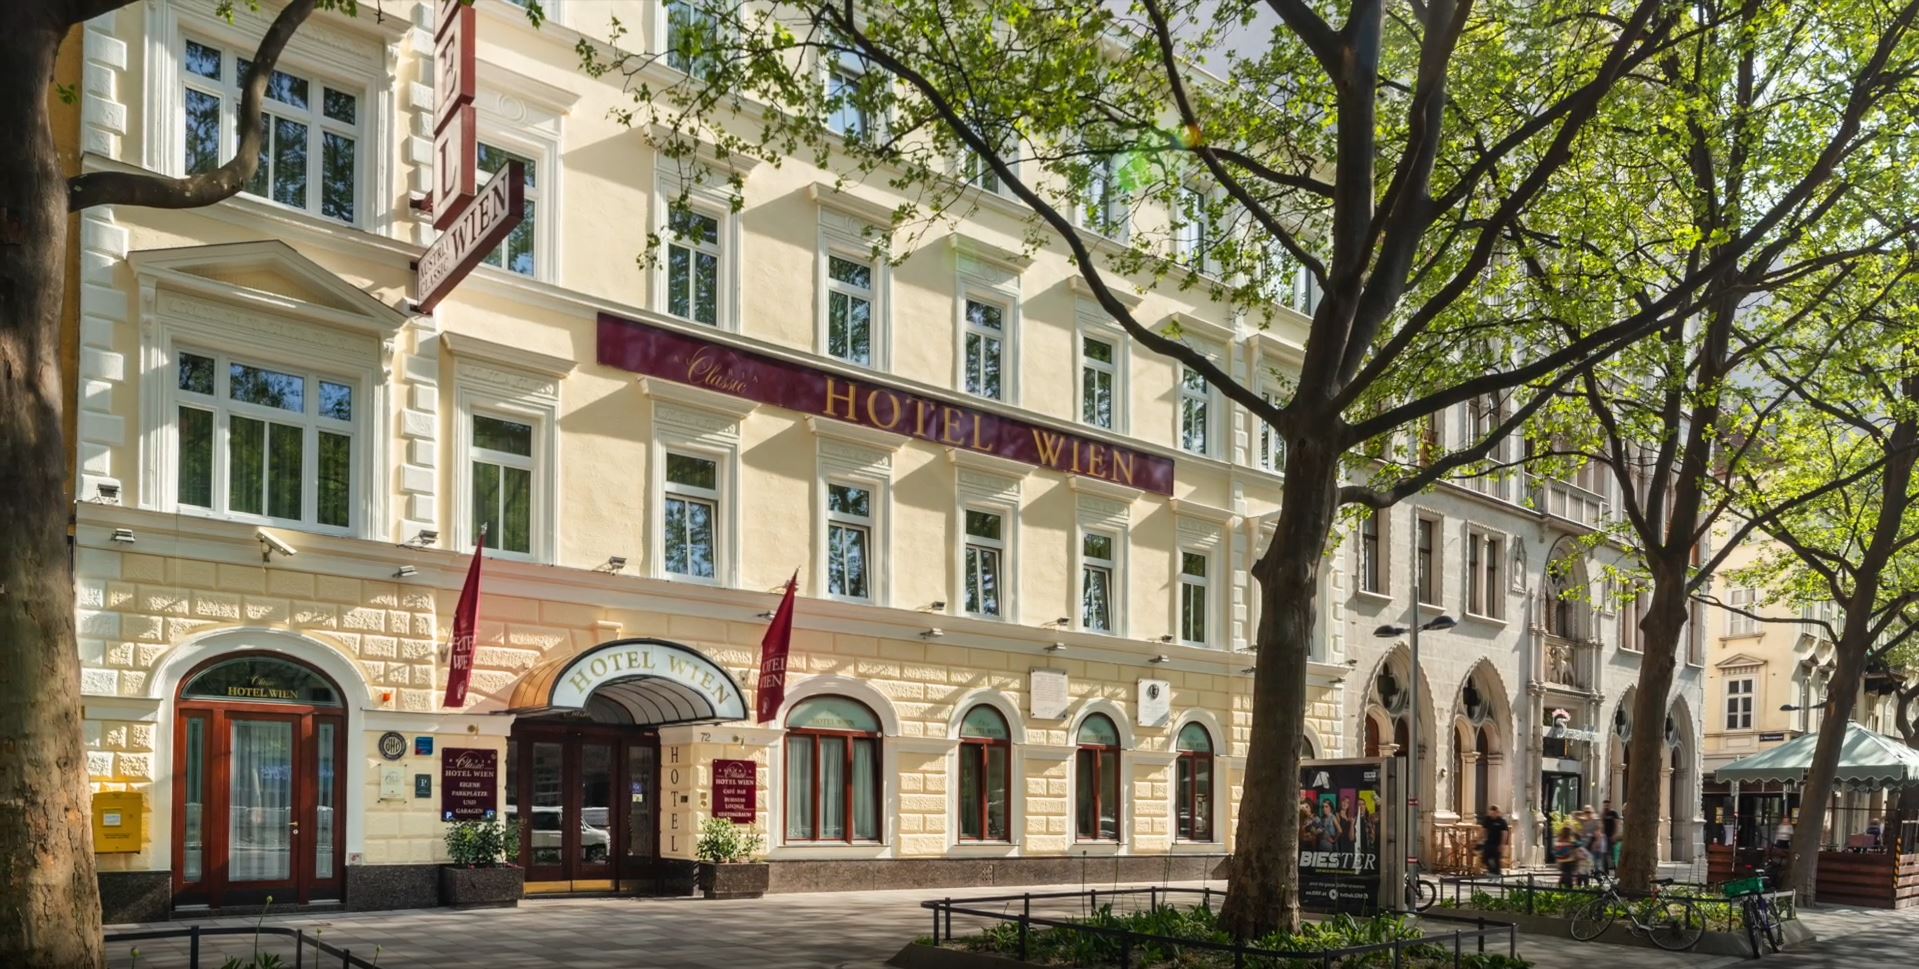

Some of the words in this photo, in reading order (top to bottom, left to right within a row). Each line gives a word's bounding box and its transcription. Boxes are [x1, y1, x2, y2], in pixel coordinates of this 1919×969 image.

[452, 173, 508, 260] WIEN
[419, 256, 449, 296] CLASSIC
[688, 354, 748, 393] Classic
[823, 376, 993, 452] HOTEL
[1032, 428, 1137, 485] WIEN
[227, 686, 267, 698] HOTEL
[268, 688, 299, 699] WIEN
[568, 650, 656, 695] HOTEL
[668, 654, 732, 705] WIEN
[700, 732, 712, 742] 72
[473, 770, 495, 778] WIEN
[670, 746, 679, 852] HOTEL
[1299, 851, 1377, 871] BIESTER
